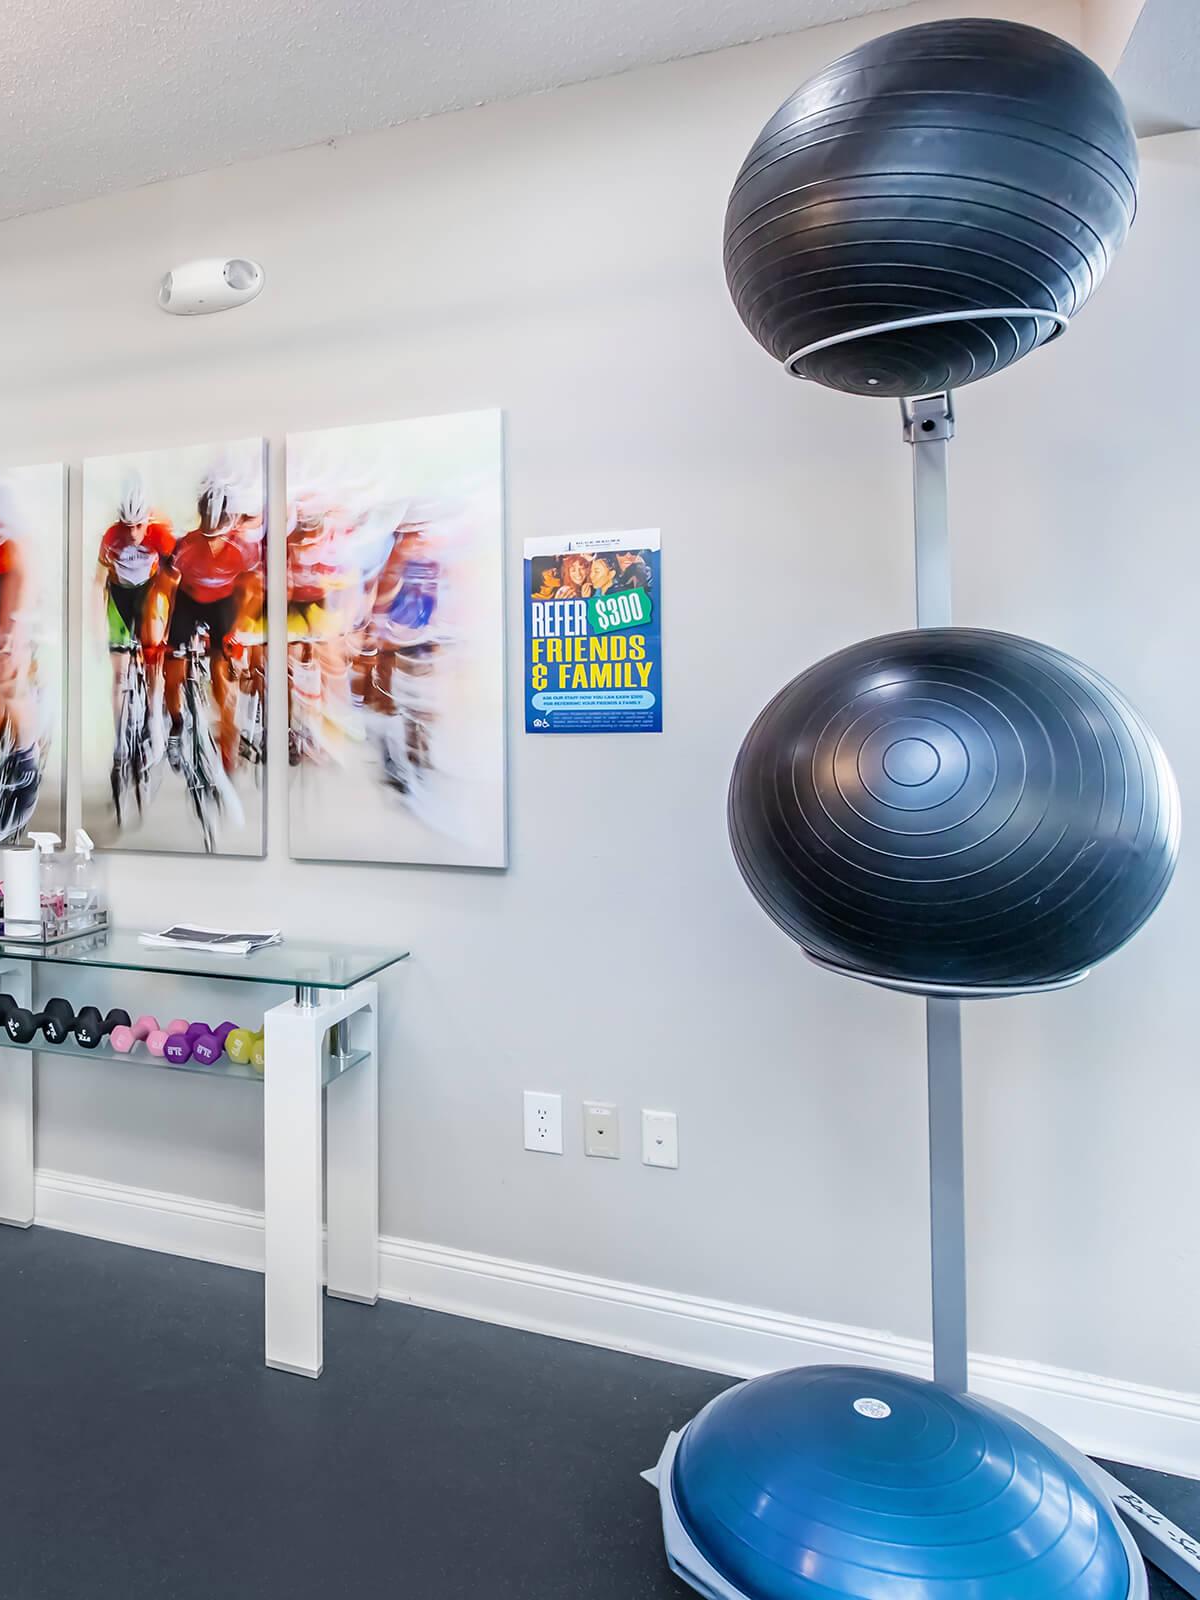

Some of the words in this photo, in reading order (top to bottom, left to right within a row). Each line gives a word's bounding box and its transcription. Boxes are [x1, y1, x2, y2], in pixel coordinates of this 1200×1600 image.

[532, 600, 587, 638] REFER
[595, 592, 644, 630] $300
[532, 634, 646, 663] FRIENDS
[532, 663, 548, 691] &
[559, 662, 653, 689] FAMILY
